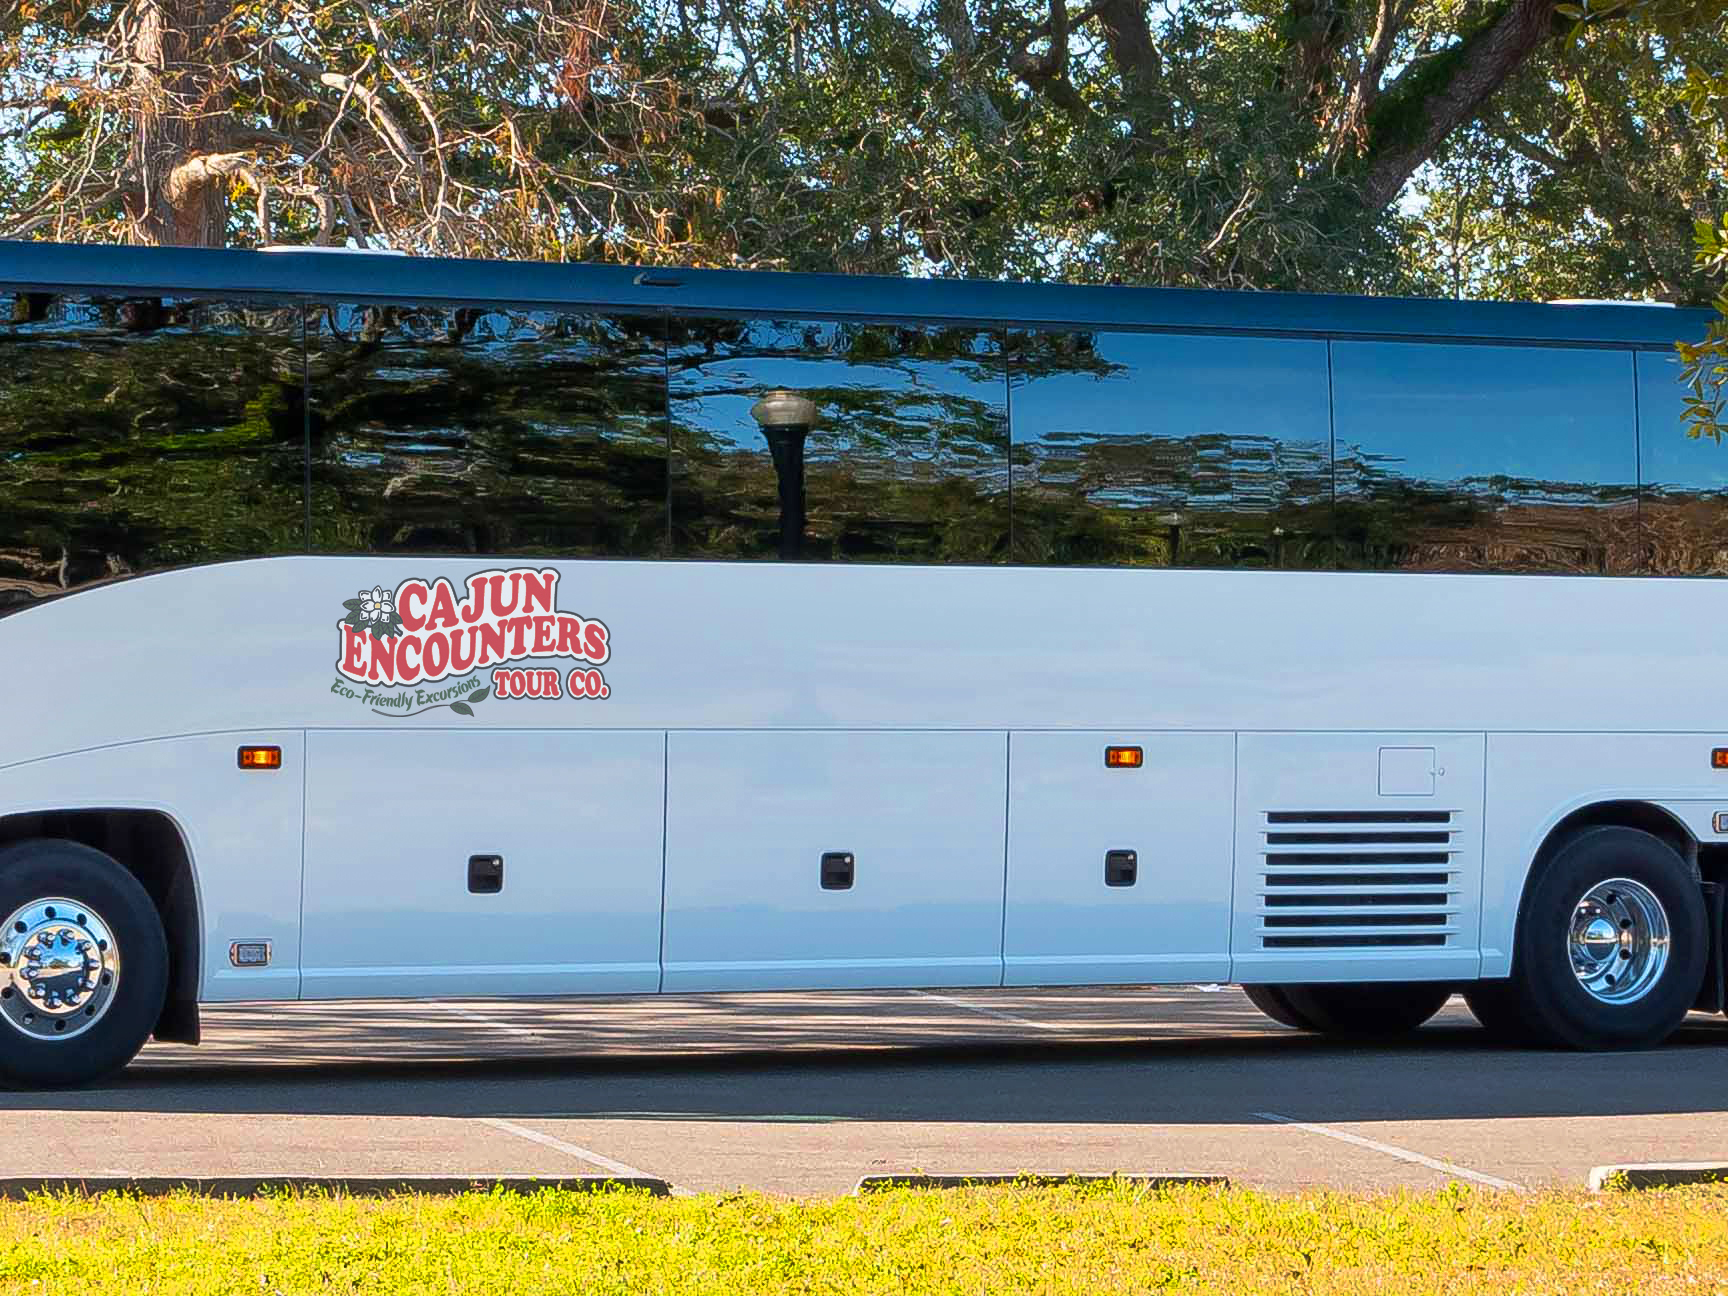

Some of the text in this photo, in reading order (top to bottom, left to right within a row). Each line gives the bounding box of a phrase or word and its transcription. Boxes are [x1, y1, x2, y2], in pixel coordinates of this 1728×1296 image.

[398, 572, 555, 632] CAJUN
[342, 614, 606, 682] ENCOUNTERS
[330, 675, 481, 711] Eco-Friendly Excursions
[494, 670, 608, 697] TOUR CO.
